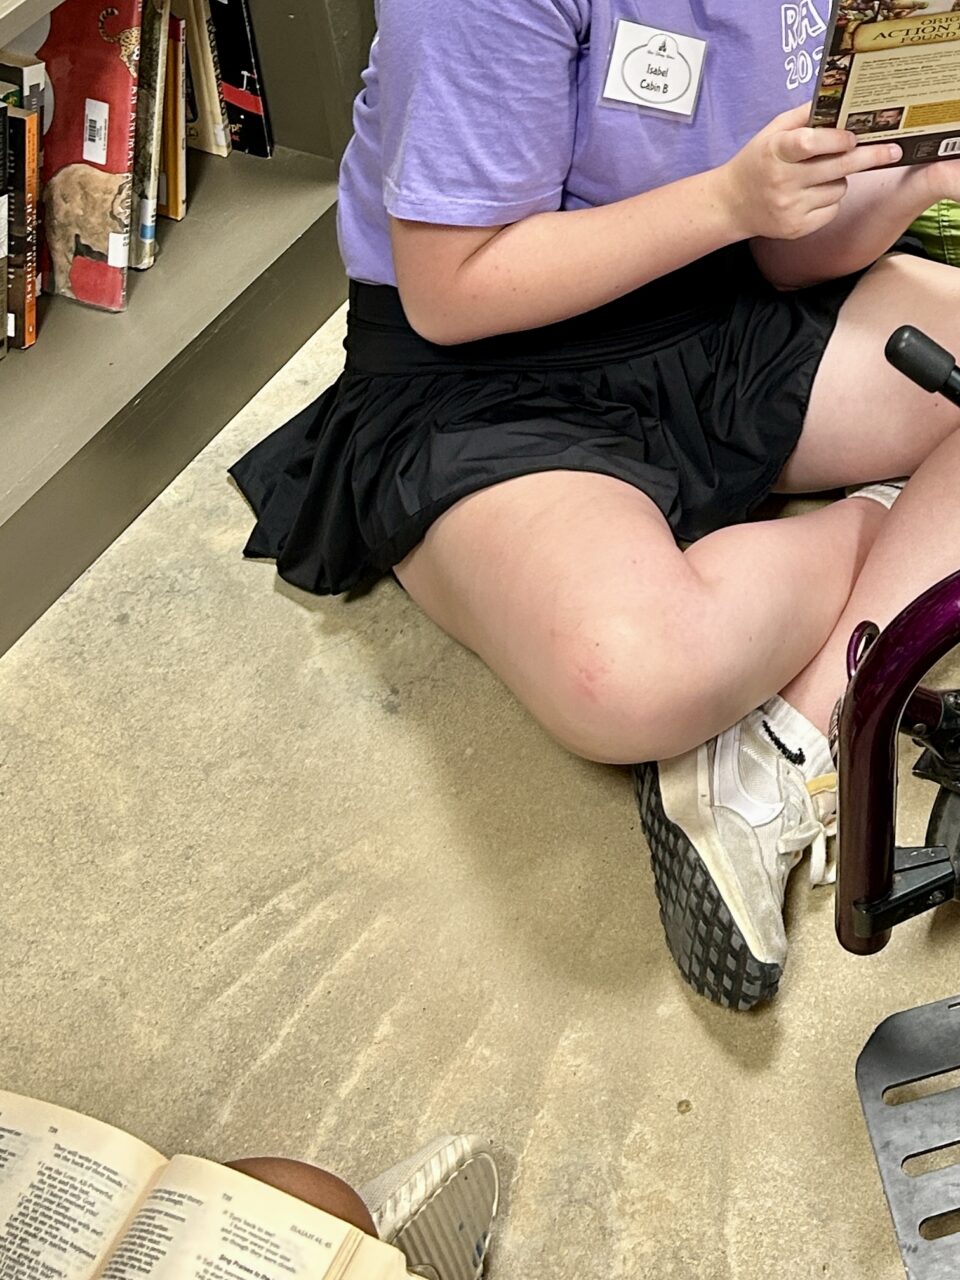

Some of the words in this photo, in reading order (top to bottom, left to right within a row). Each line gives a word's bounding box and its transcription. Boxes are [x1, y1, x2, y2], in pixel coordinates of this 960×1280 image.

[872, 23, 950, 41] ACTION
[901, 30, 957, 44] FOUND
[646, 63, 669, 78] Isabel
[639, 79, 661, 93] Cabin
[661, 83, 669, 94] B
[24, 251, 34, 303] HORSE
